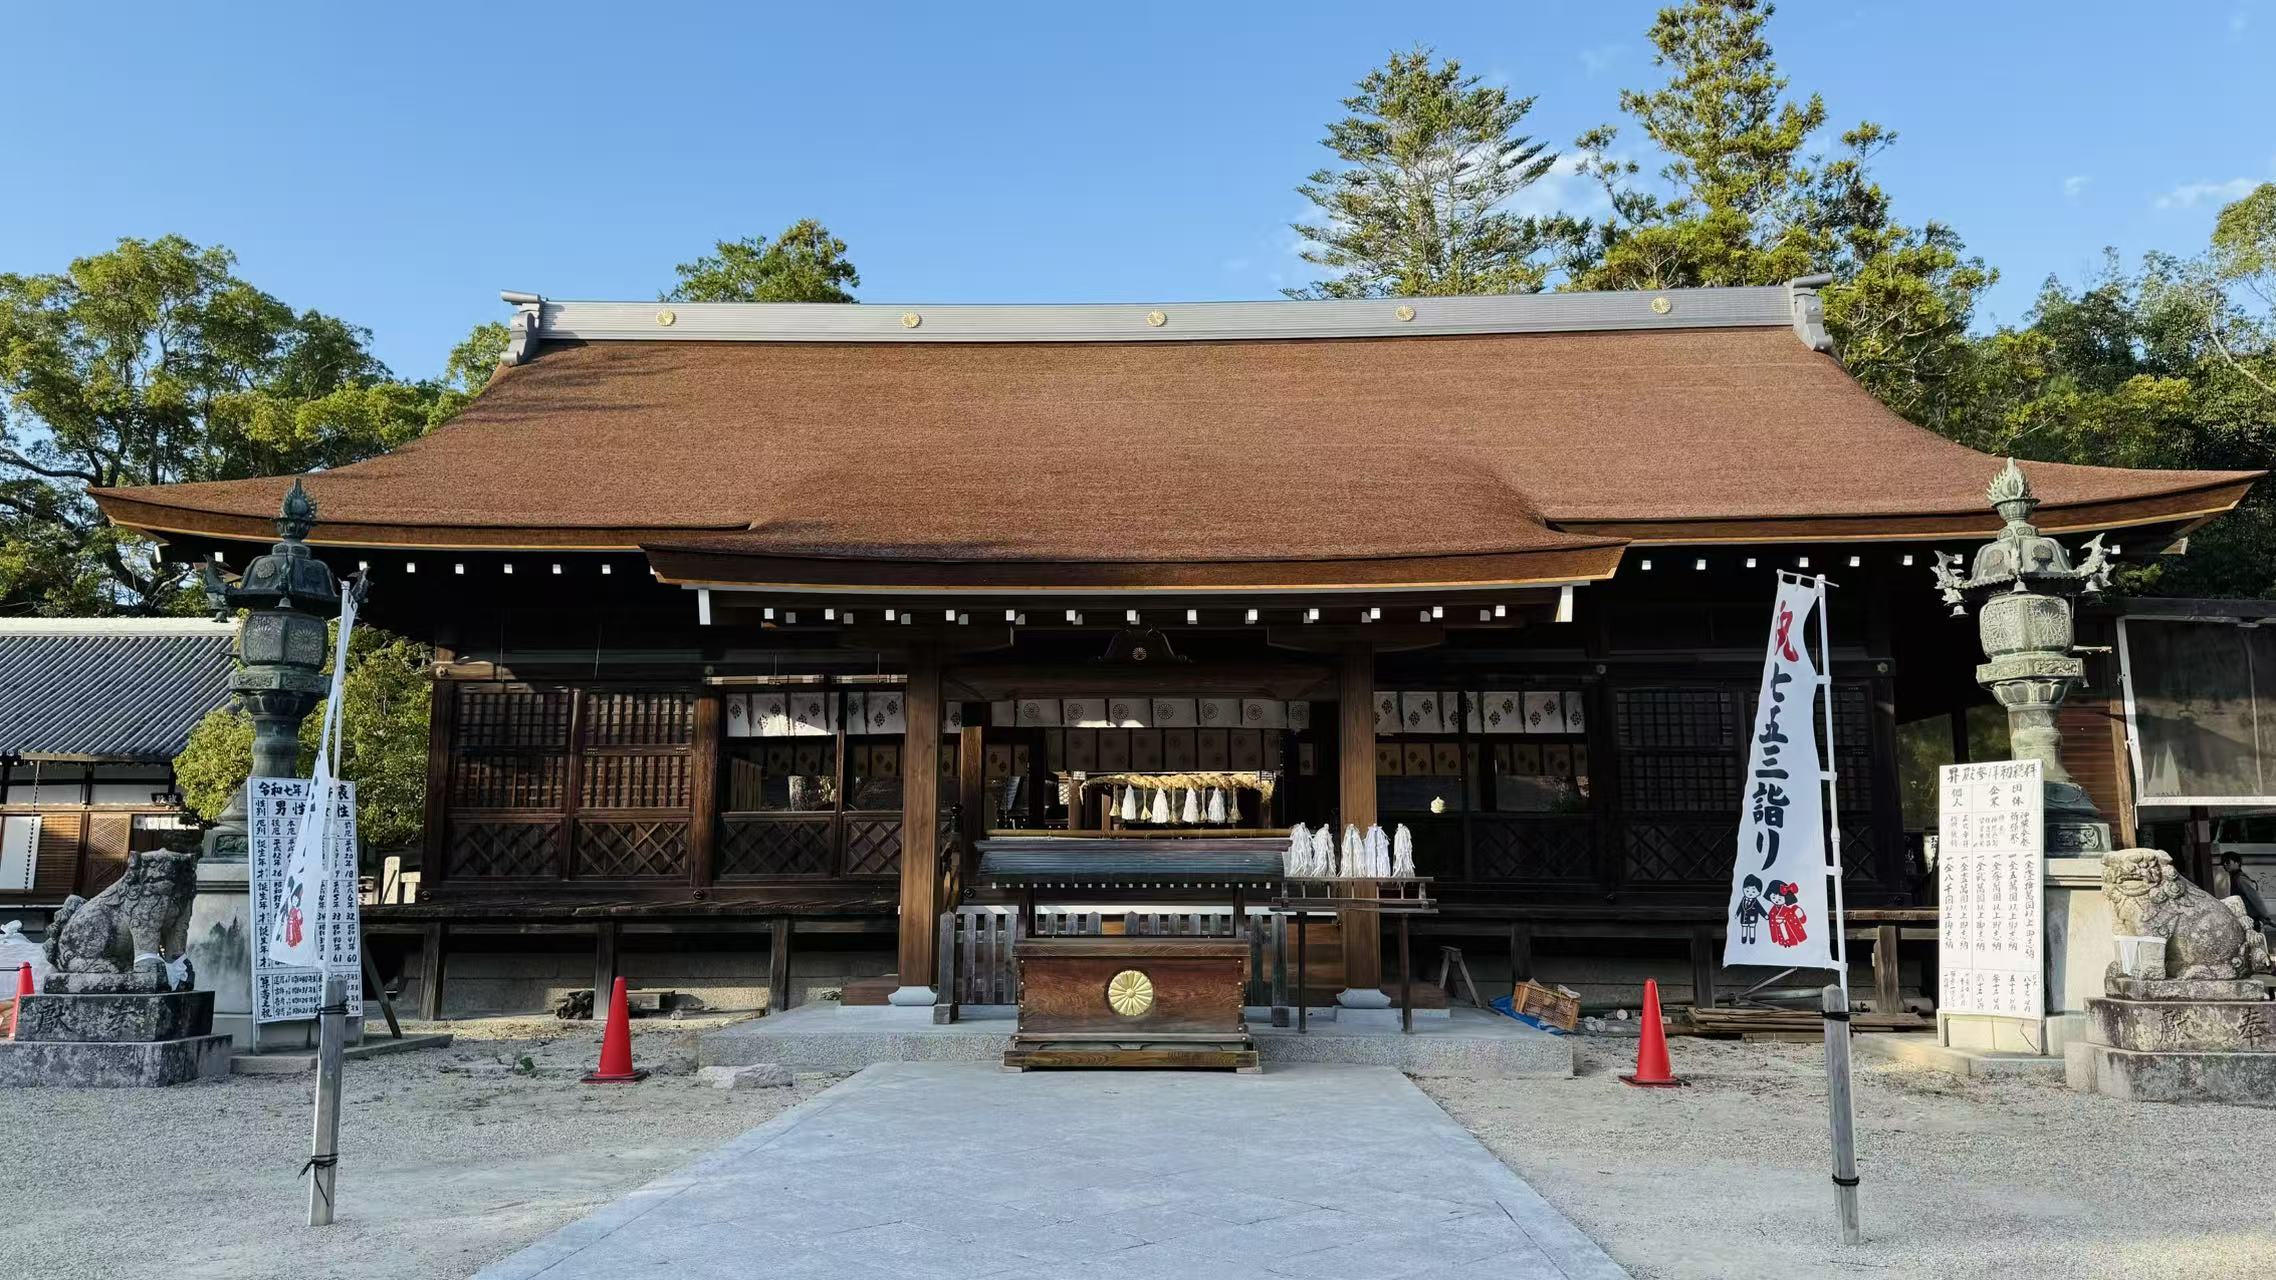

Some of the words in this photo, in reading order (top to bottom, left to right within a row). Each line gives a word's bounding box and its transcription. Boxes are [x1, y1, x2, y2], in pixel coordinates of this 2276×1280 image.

[1951, 788, 1963, 807] 個人
[1989, 785, 2000, 808] 企業
[2012, 783, 2024, 806] 団体
